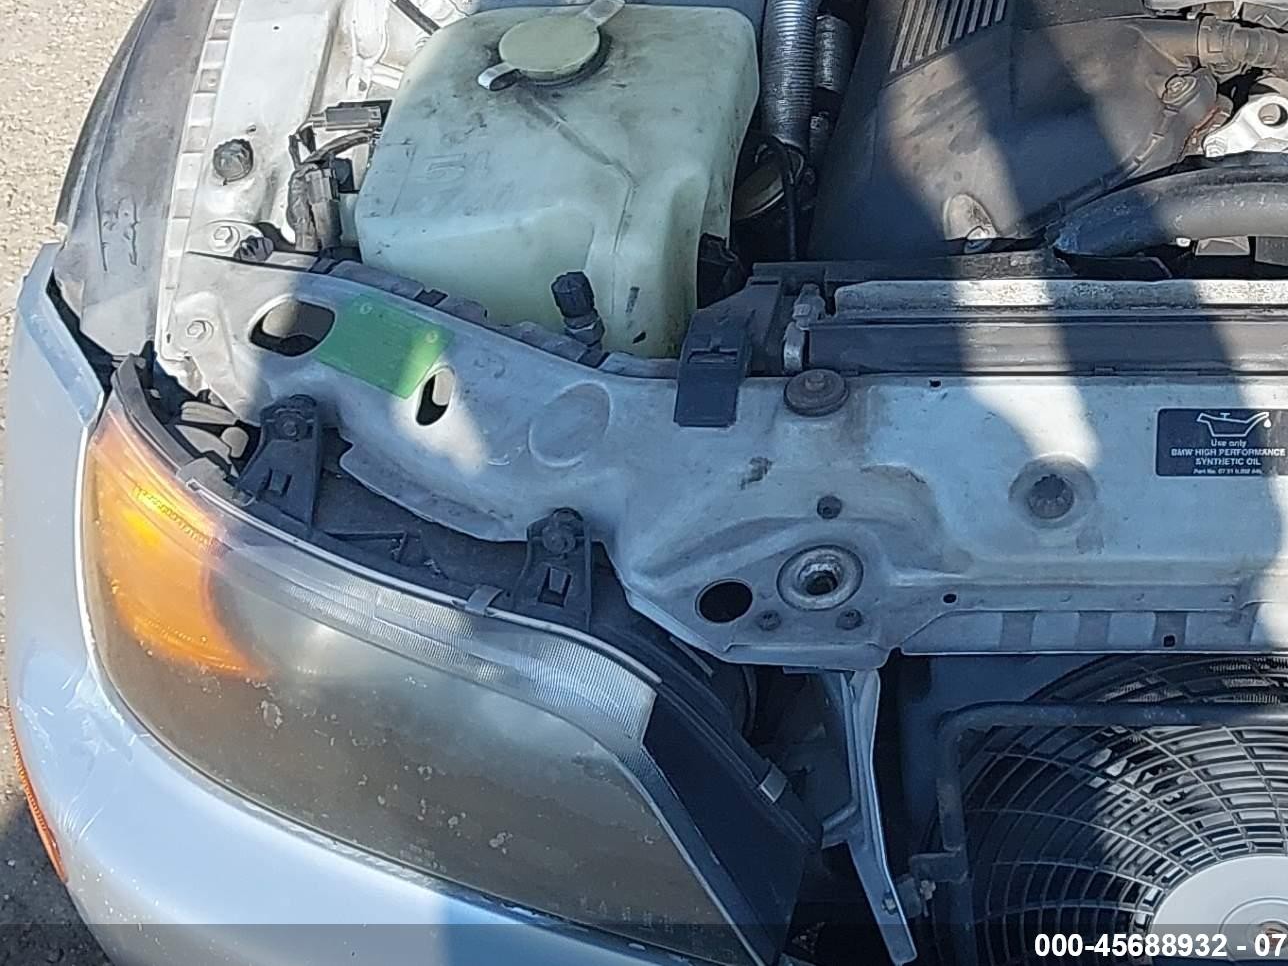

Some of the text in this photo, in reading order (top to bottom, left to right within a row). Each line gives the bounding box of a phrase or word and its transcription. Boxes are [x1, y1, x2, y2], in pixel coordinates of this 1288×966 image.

[1210, 439, 1247, 448] Use only
[1171, 448, 1286, 456] BMW HIGH PERFORMANCE
[1195, 458, 1244, 466] SYNTHETIC
